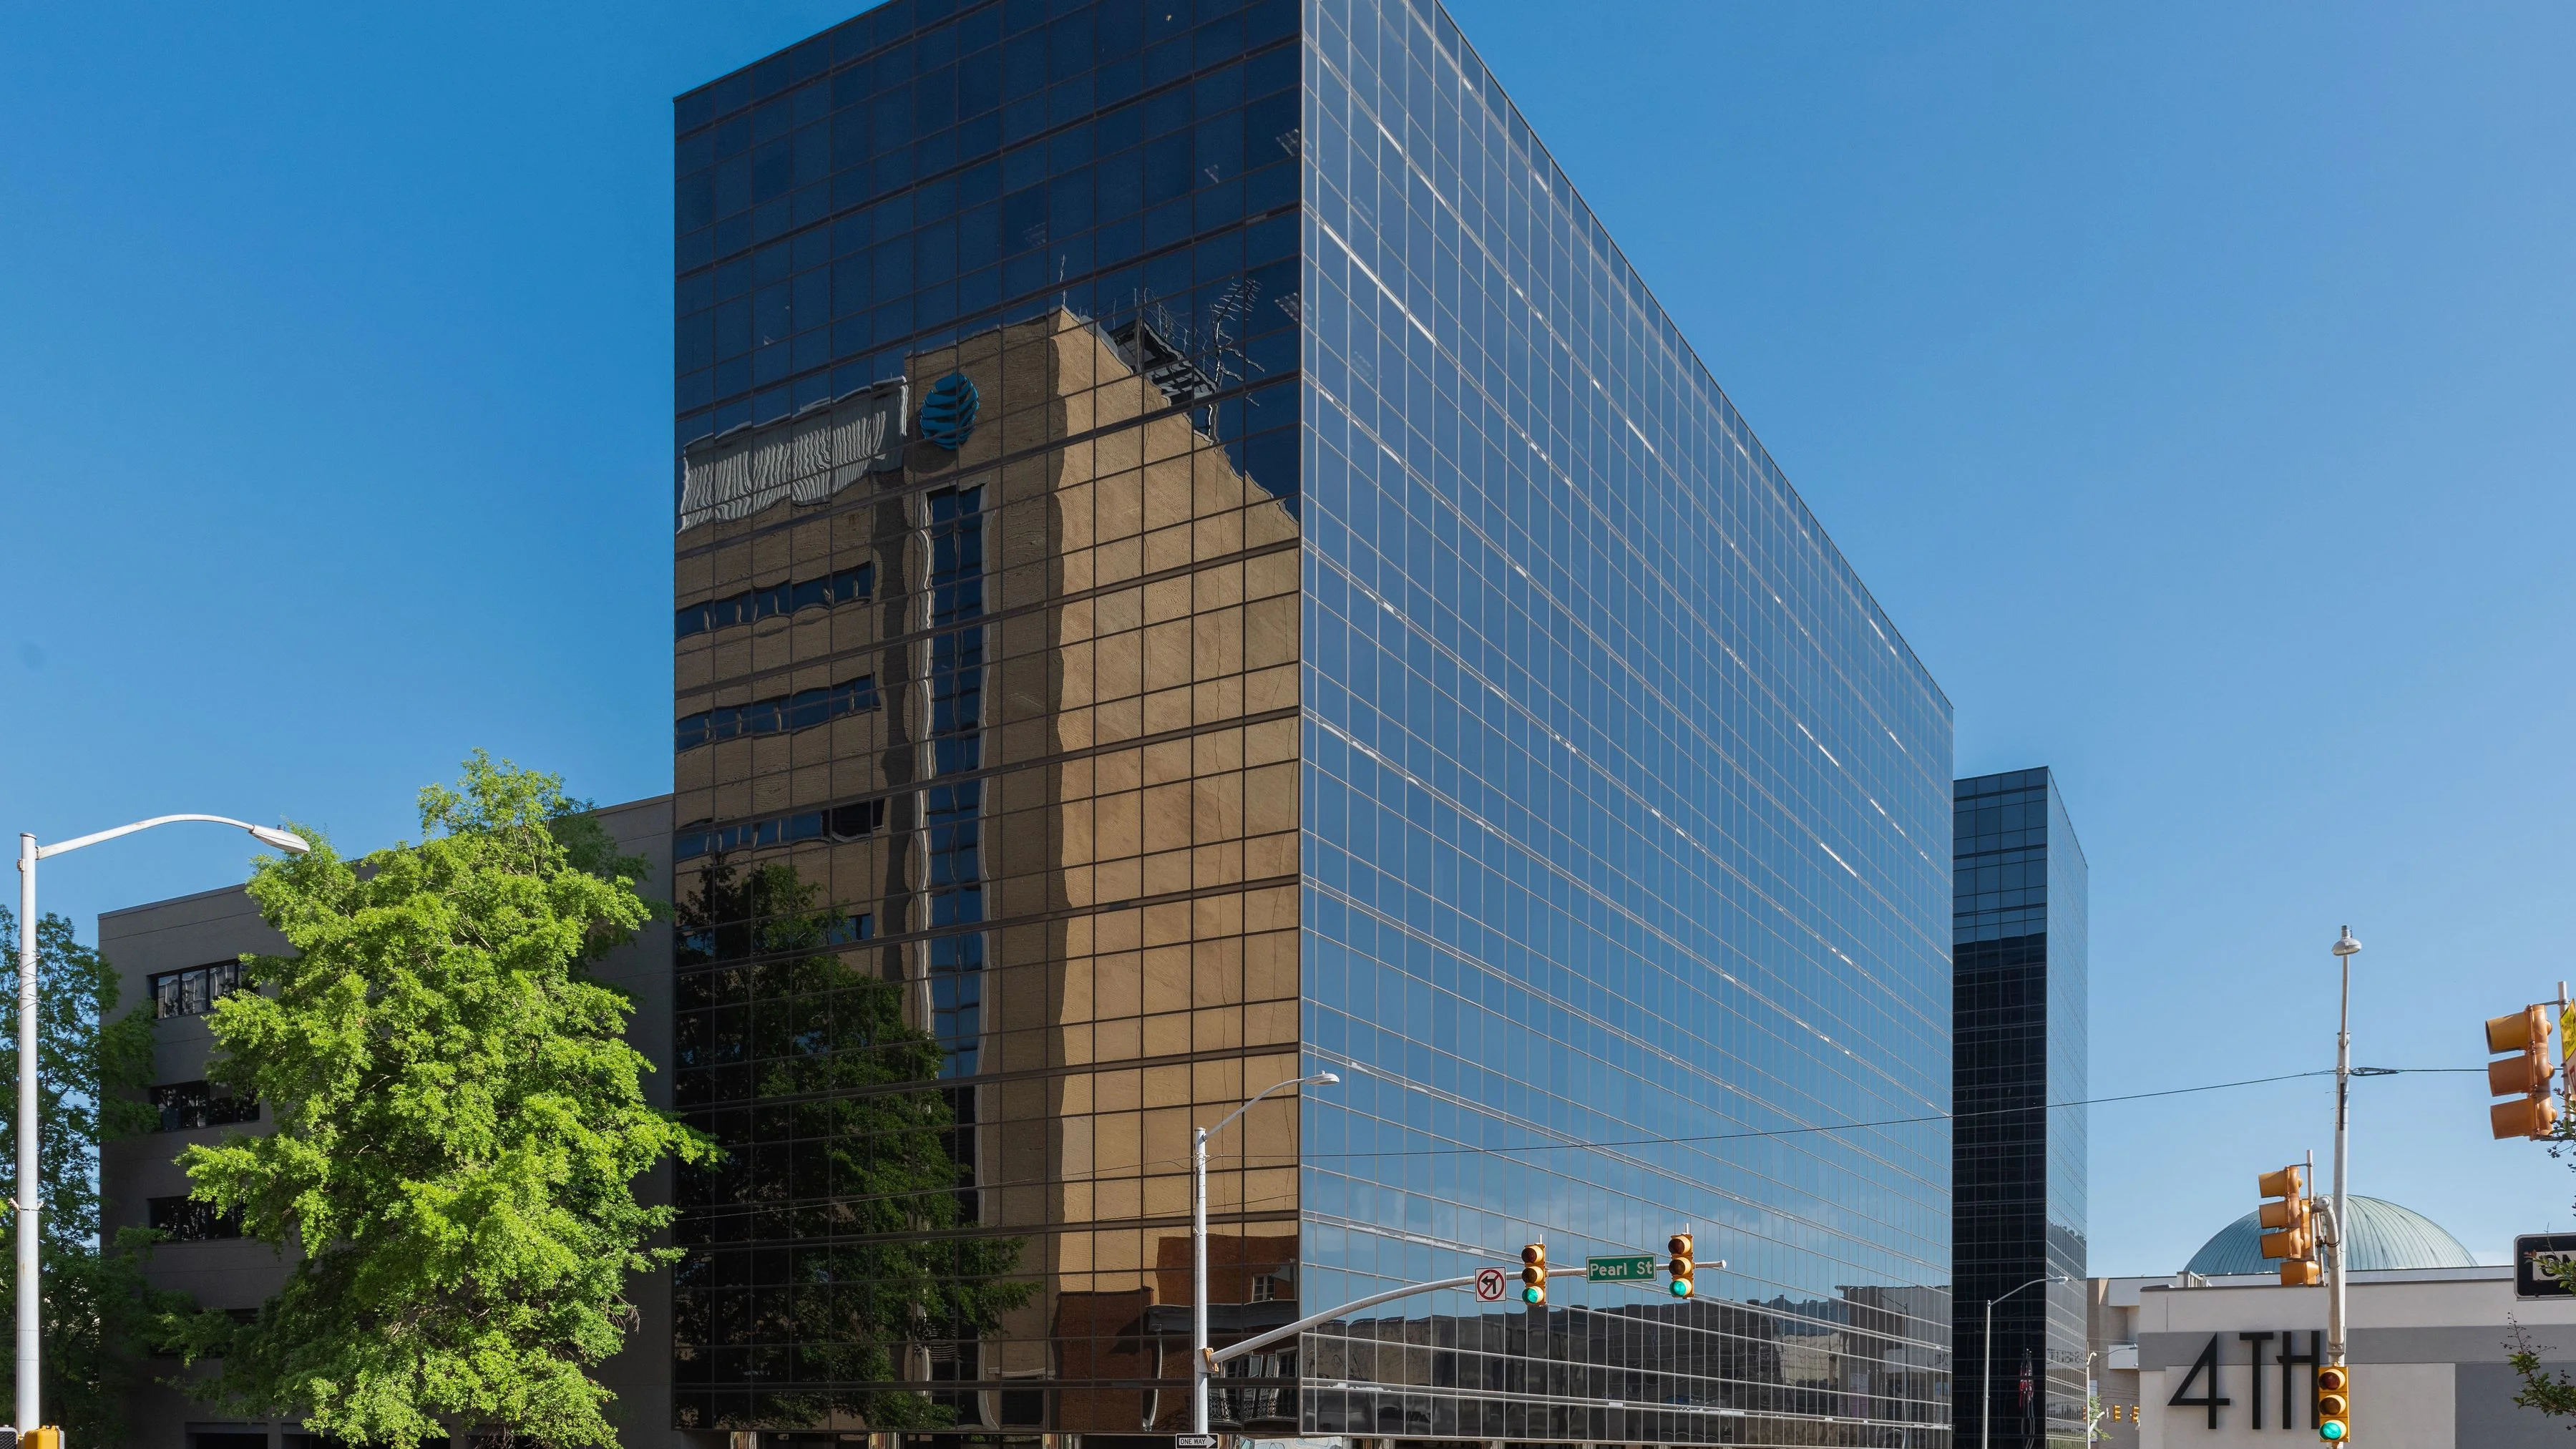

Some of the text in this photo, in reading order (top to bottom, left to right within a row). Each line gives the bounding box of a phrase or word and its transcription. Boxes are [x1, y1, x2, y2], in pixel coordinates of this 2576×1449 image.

[1590, 1261, 1652, 1277] Pearl St
[2167, 1331, 2320, 1430] 4TH
